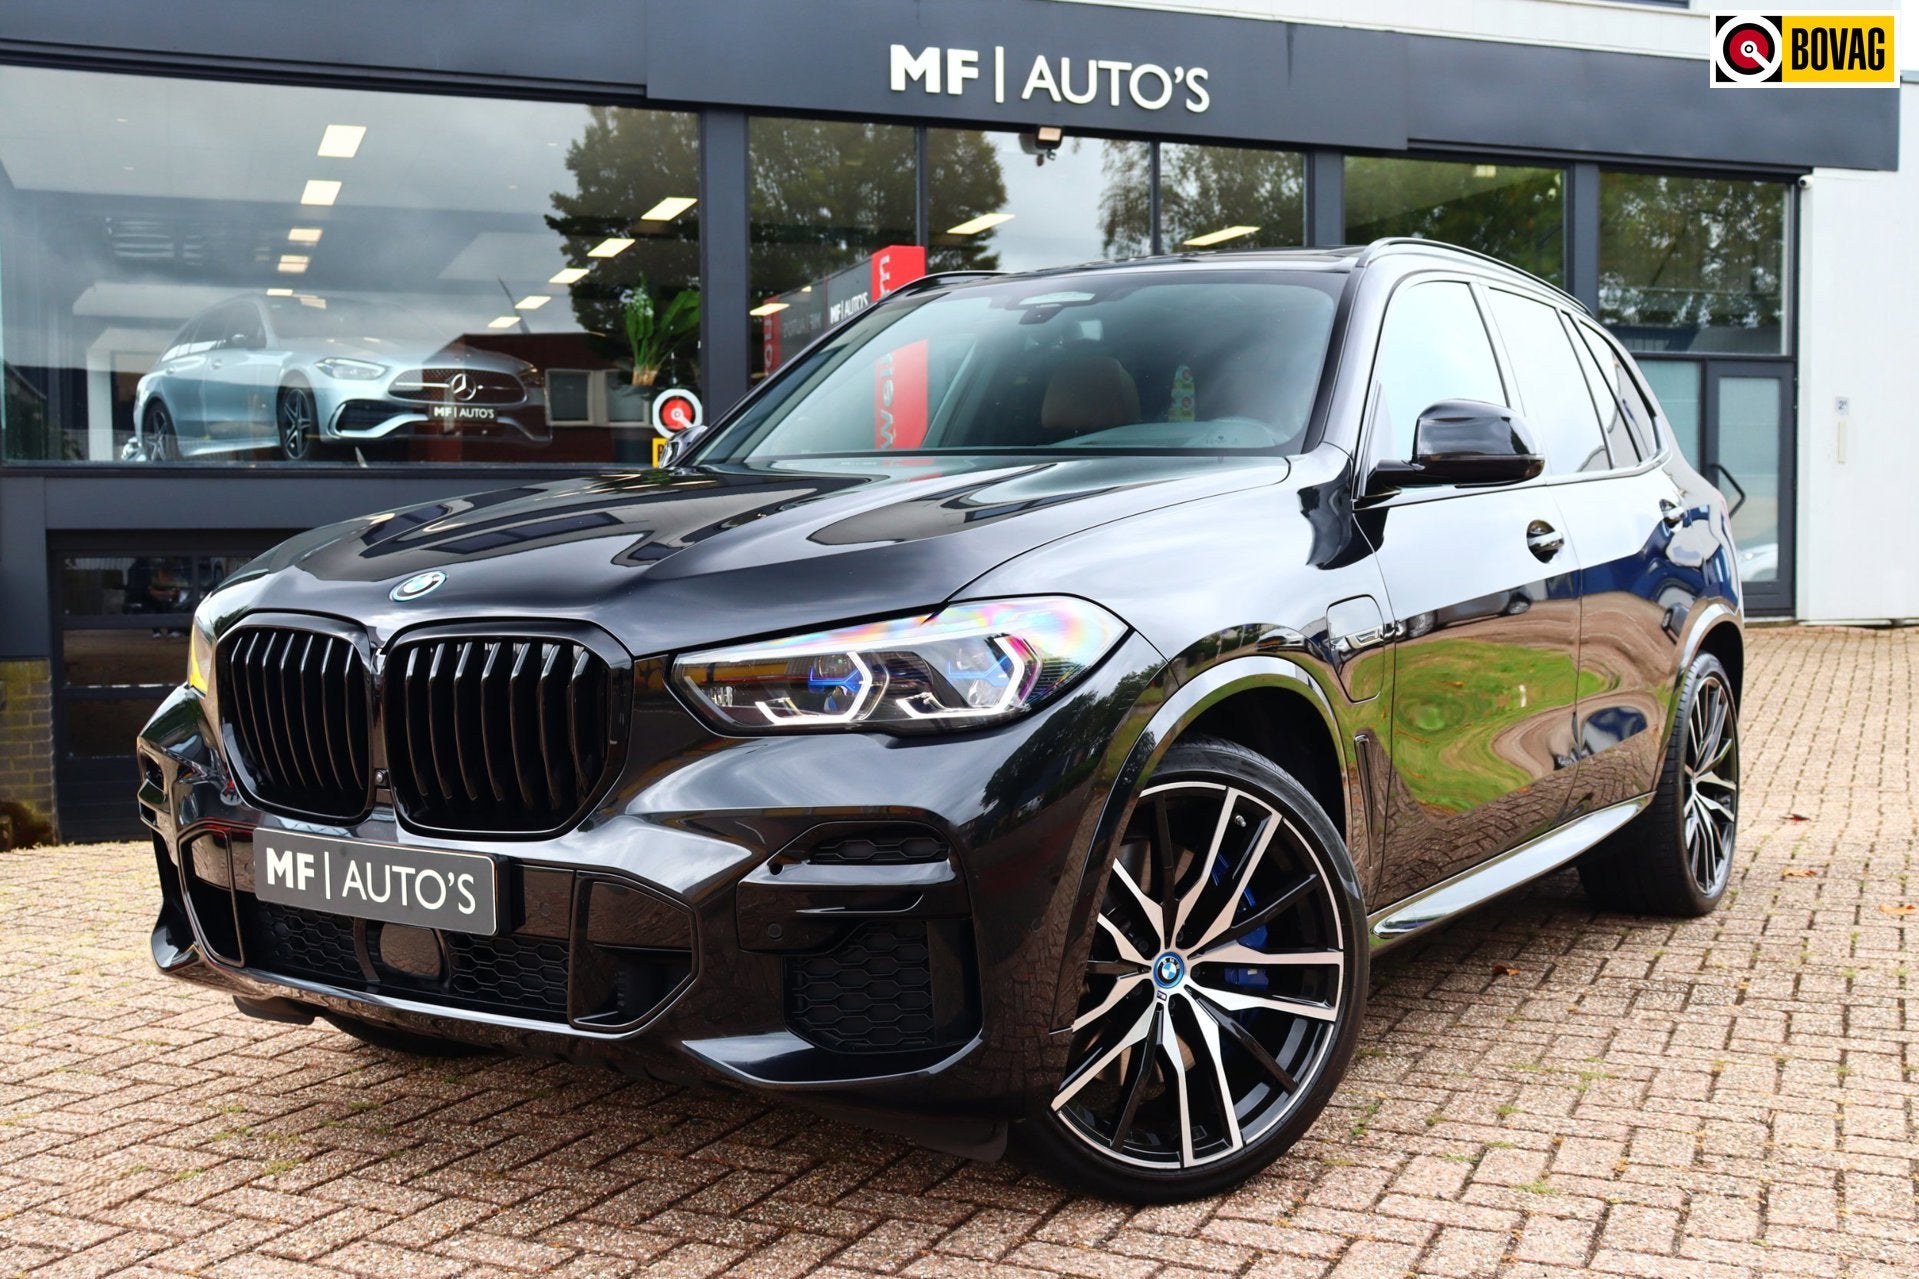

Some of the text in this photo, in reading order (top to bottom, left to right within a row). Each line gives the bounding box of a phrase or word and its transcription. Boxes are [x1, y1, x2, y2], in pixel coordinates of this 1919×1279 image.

[890, 44, 1210, 113] MF AUTO'S
[433, 406, 495, 419] MF AUTO'S
[266, 847, 476, 915] MF AUTO'S
